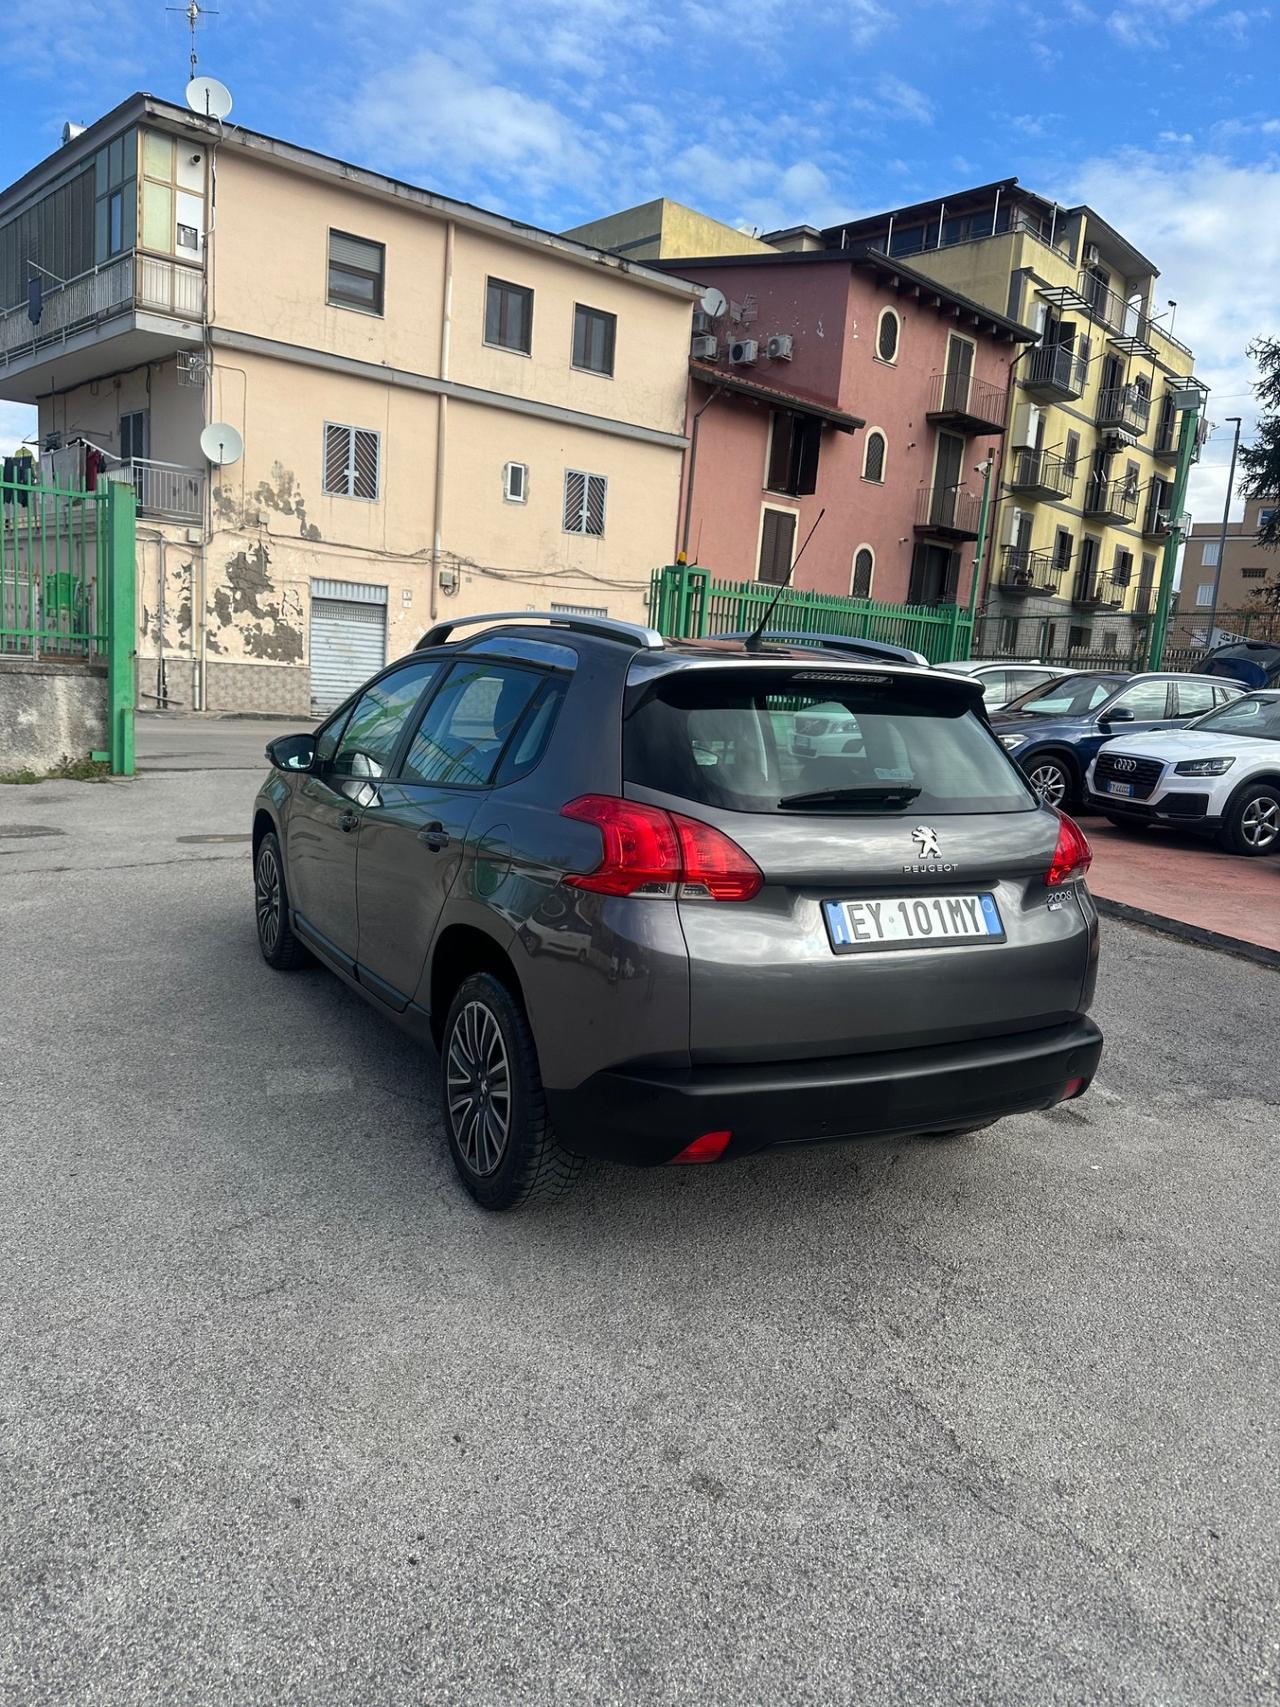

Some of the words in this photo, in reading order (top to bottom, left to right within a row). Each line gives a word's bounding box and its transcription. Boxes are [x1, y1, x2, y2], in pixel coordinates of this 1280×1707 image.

[903, 863, 959, 873] PEUGEOT
[1047, 890, 1073, 903] 2008
[847, 903, 884, 940] EY
[898, 899, 980, 936] 101MY
